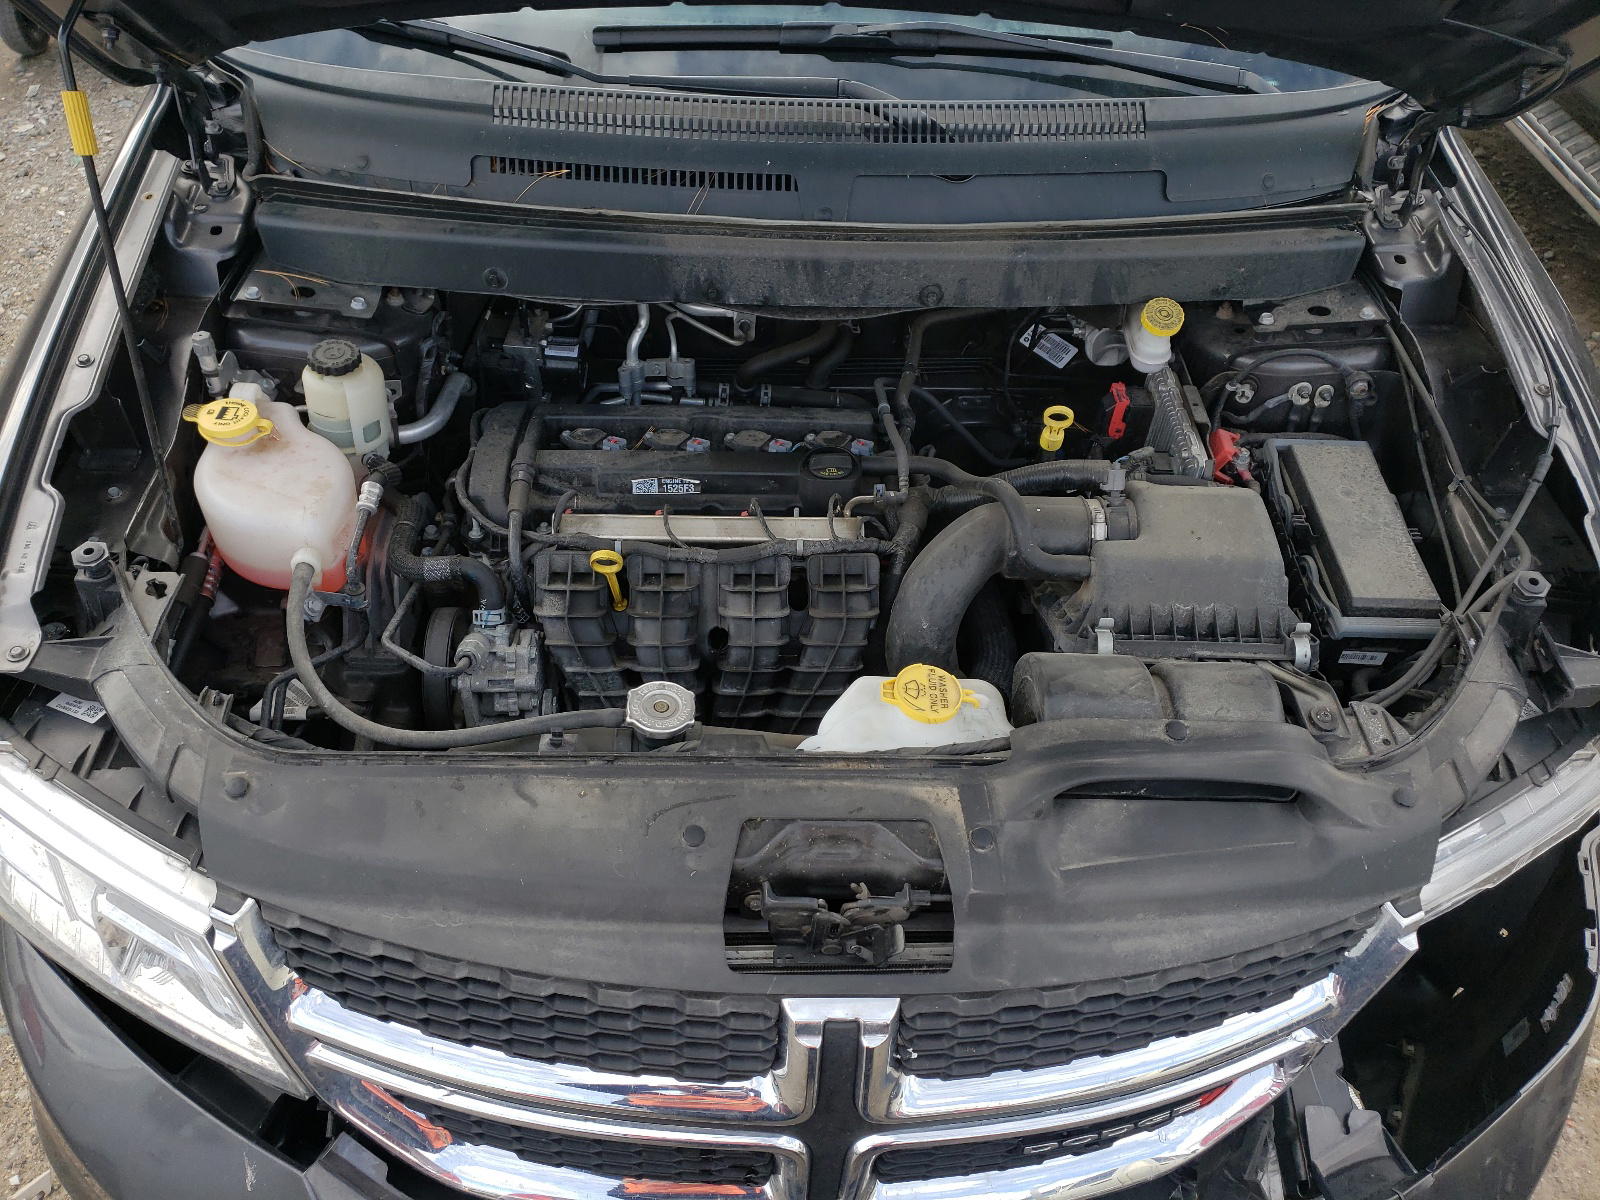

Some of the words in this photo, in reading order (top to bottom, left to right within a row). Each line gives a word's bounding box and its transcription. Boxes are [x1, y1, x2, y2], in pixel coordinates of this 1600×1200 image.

[662, 483, 695, 493] 1525F3
[927, 668, 937, 692] FLUID
[937, 674, 949, 709] WASHER
[929, 693, 940, 714] ONLY
[1023, 1098, 1203, 1155] DODGE
